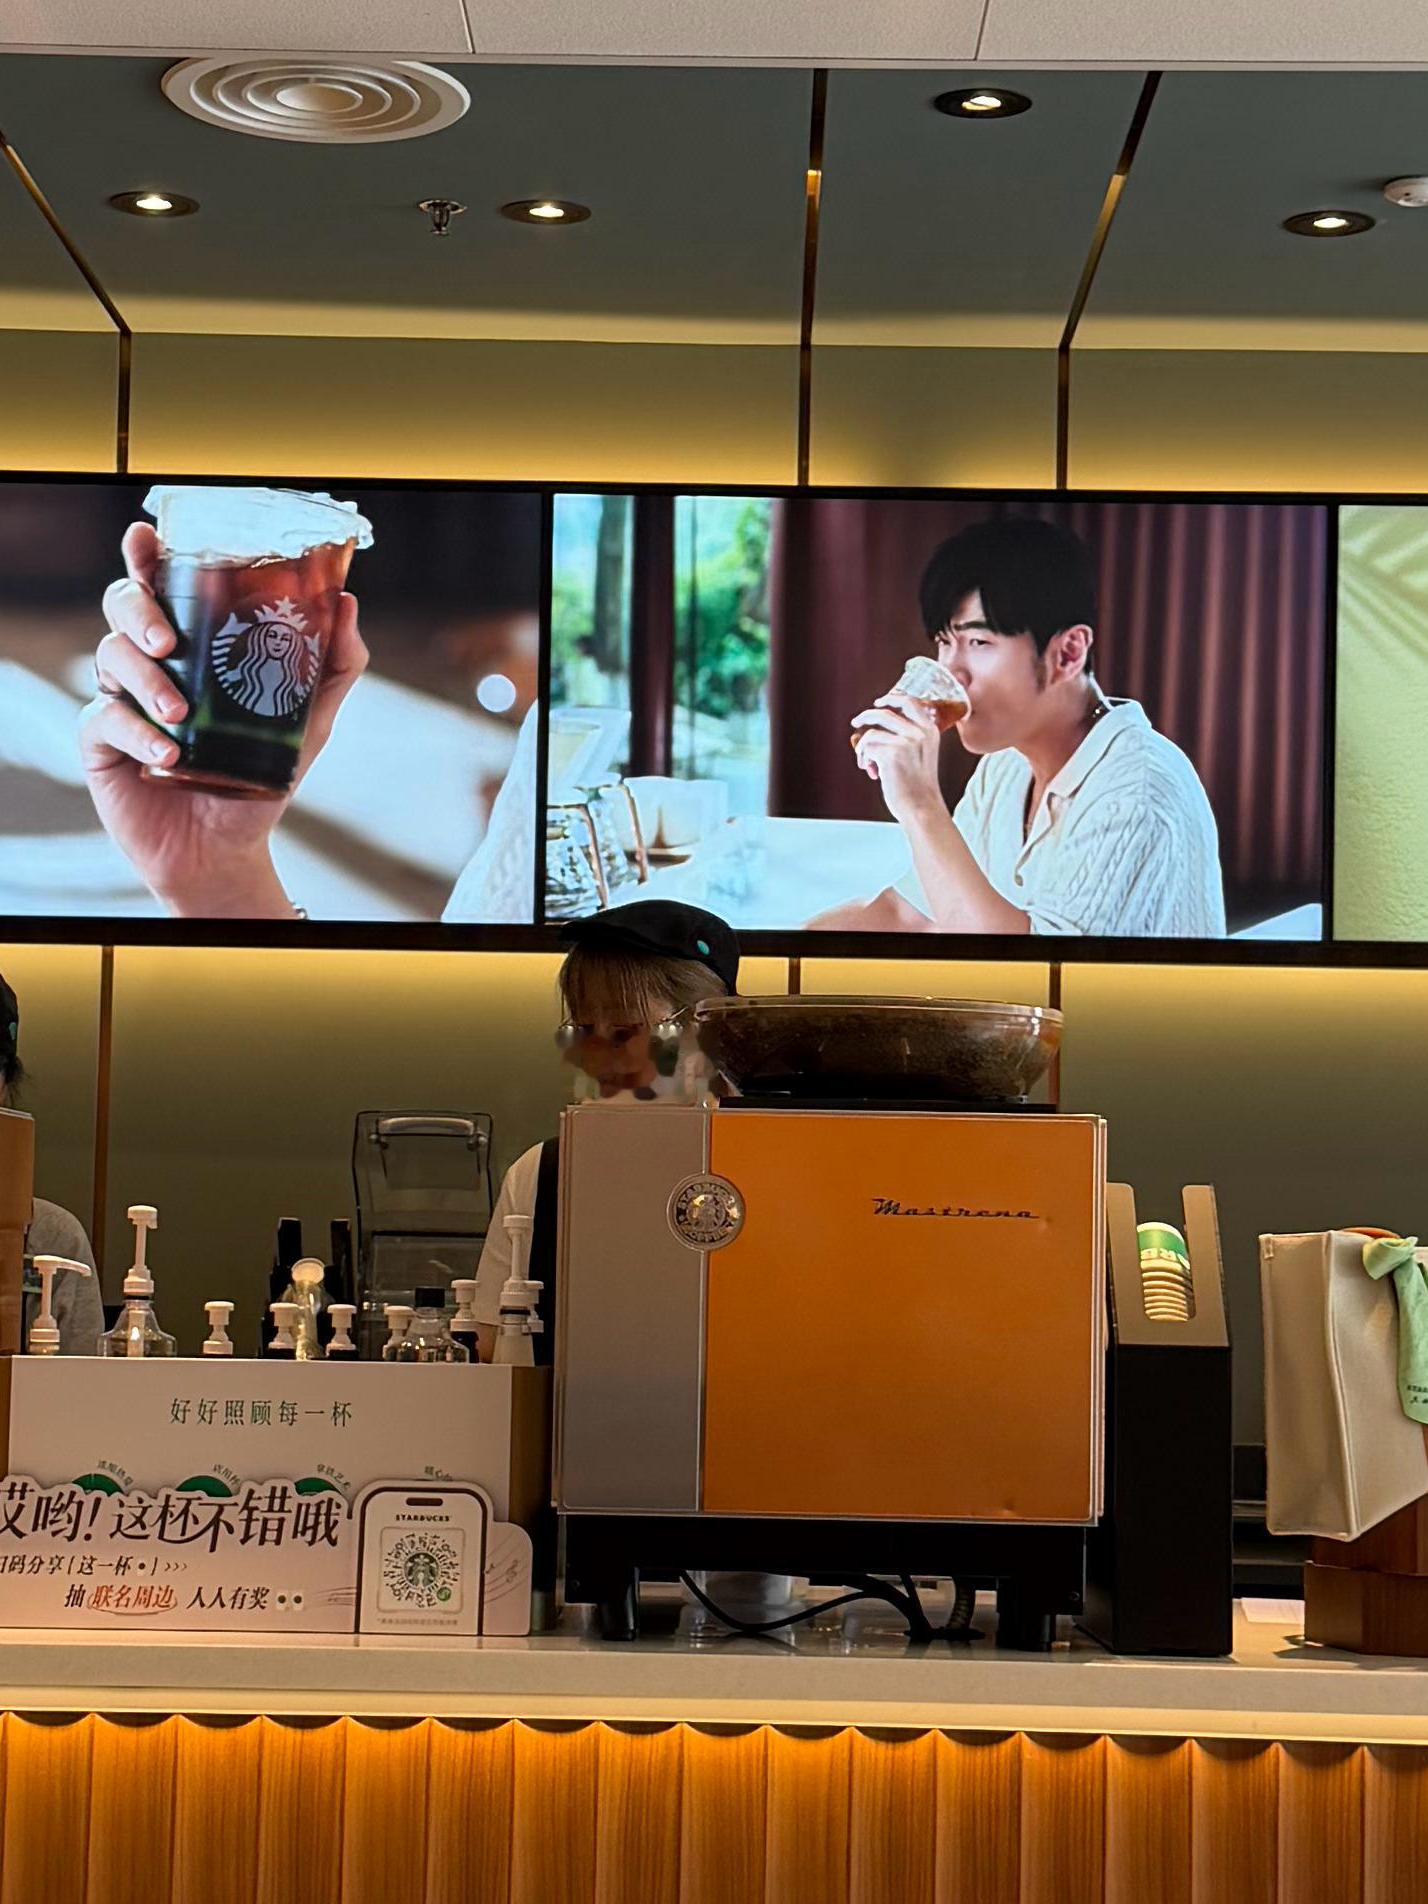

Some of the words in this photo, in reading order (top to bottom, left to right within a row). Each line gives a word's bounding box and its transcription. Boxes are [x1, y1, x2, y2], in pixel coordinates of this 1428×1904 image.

[170, 1398, 353, 1427] 好好照顾每一杯
[90, 1583, 174, 1610] 联名周边
[186, 1585, 271, 1610] 人人有奖
